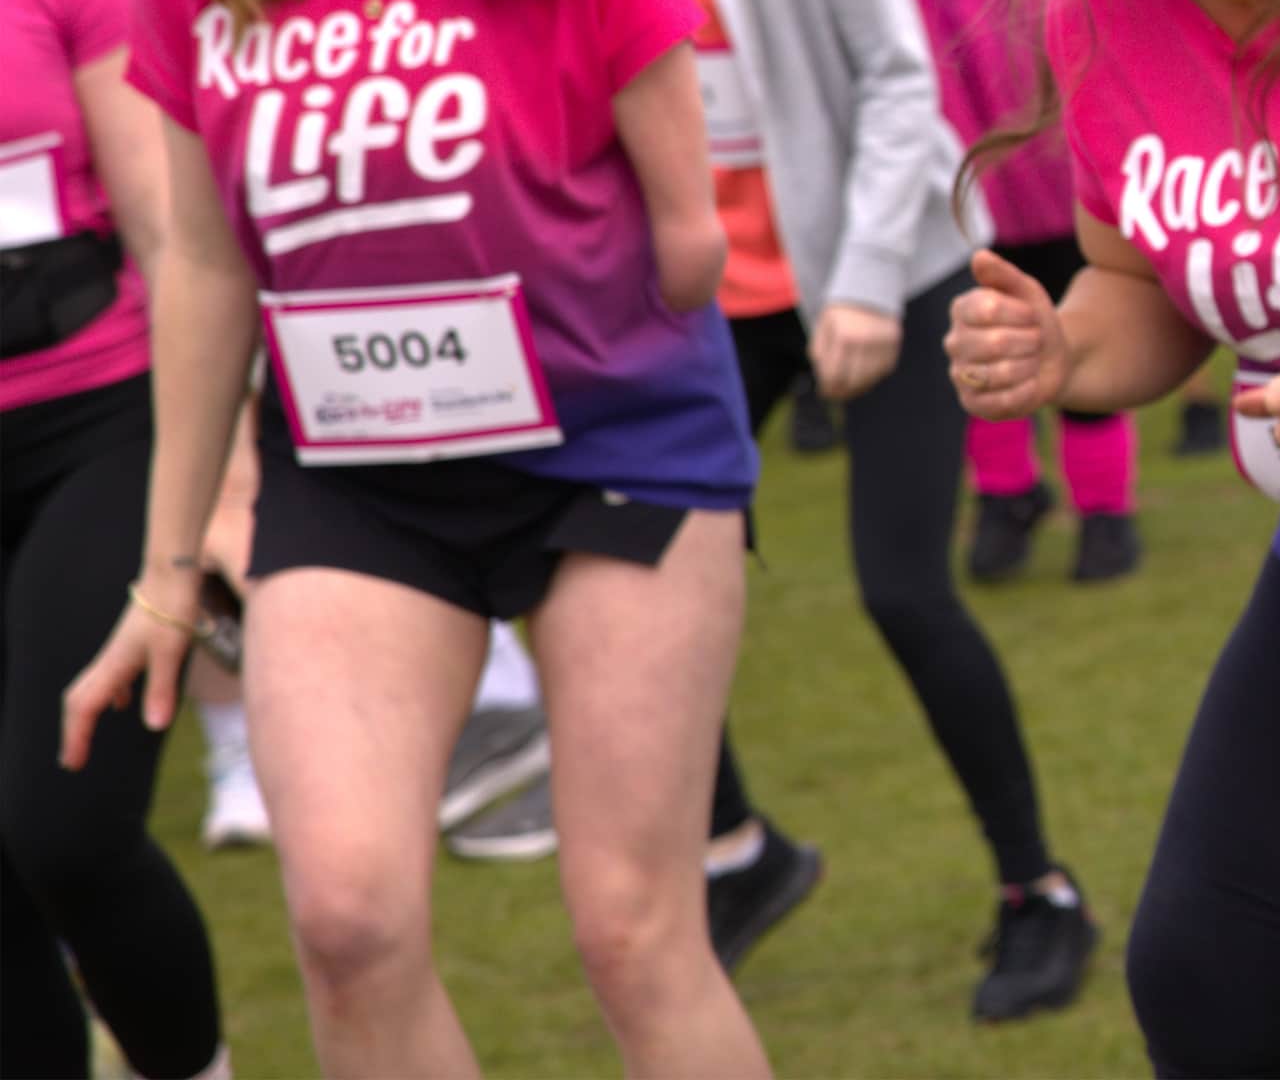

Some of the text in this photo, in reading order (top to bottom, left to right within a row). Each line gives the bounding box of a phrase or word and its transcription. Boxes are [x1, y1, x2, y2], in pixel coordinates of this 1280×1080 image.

[193, 0, 477, 99] Race for
[245, 74, 487, 219] Life
[1120, 134, 1278, 251] Race
[331, 326, 468, 373] 5004
